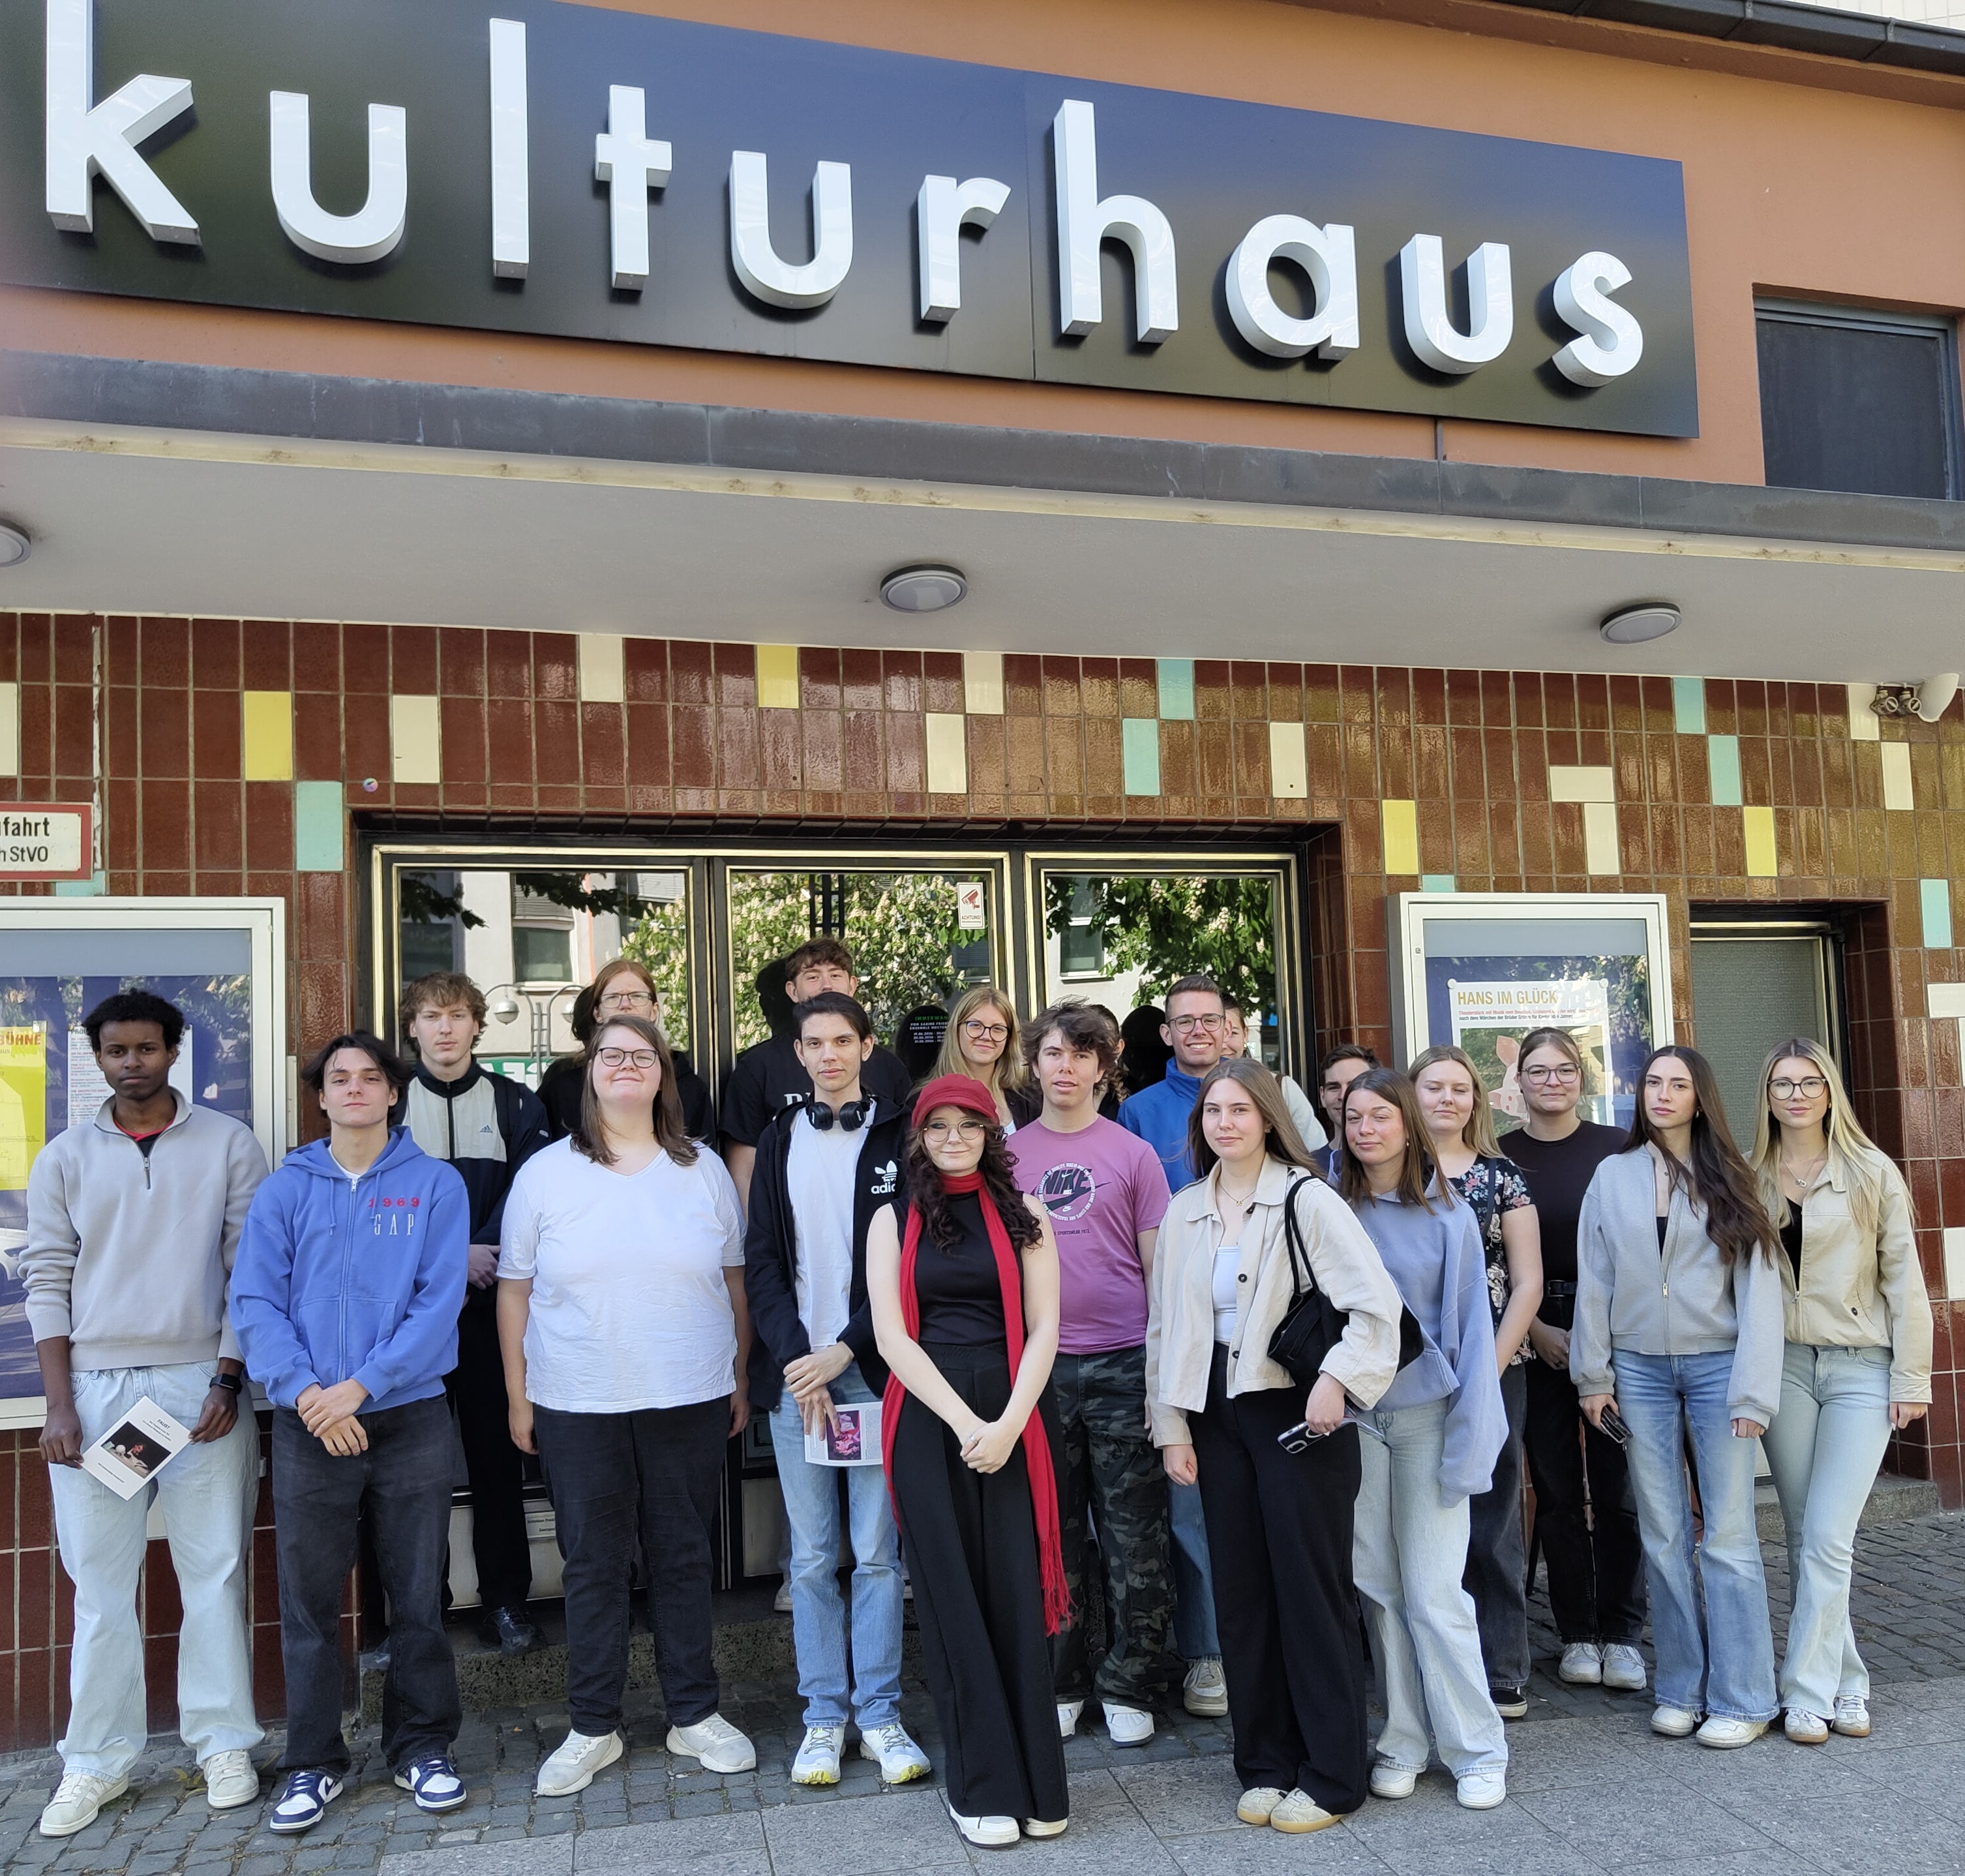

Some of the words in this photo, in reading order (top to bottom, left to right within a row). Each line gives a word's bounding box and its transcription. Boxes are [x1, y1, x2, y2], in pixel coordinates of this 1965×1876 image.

[46, 0, 1643, 388] kulturhaus
[0, 817, 50, 836] fahrt
[10, 846, 48, 862] StVO
[1458, 991, 1493, 1005] HANS
[1497, 991, 1512, 1005] IM
[1516, 988, 1557, 1004] GLÜCK
[1037, 1168, 1092, 1194] NIKE
[374, 1214, 415, 1235] GAP
[157, 1419, 171, 1429] FAUST
